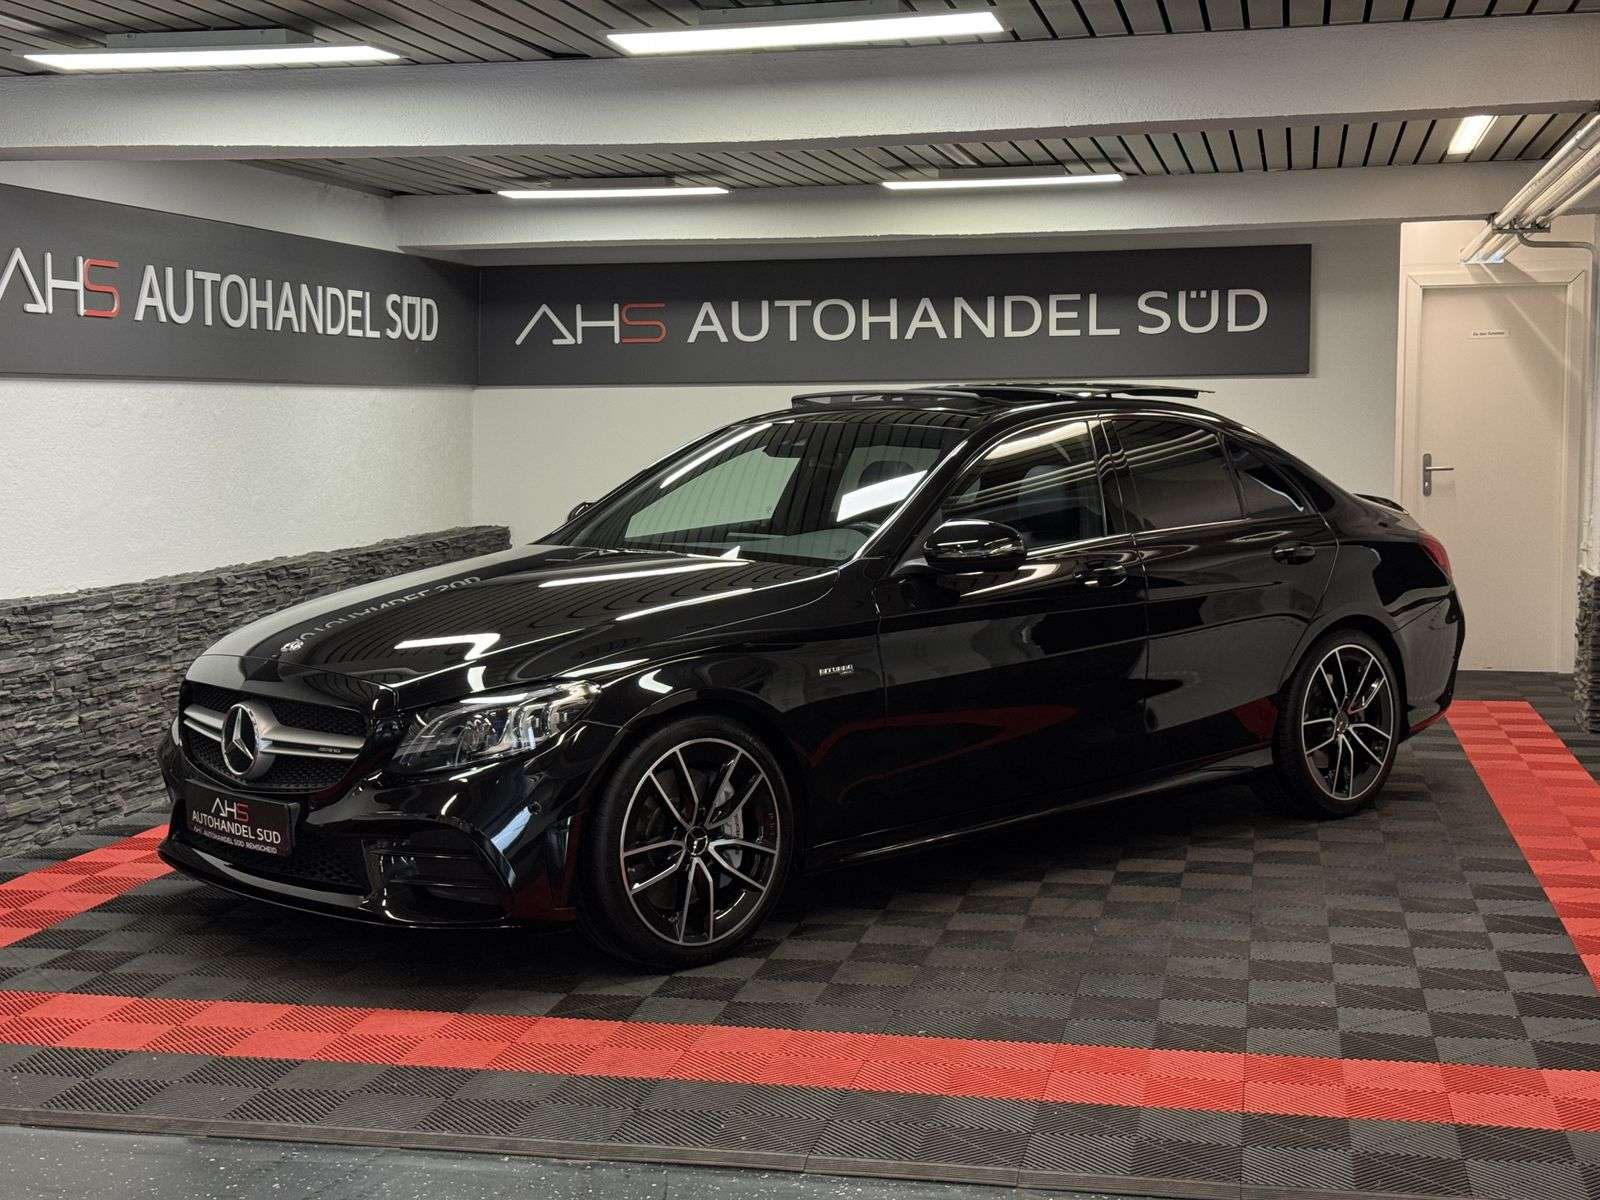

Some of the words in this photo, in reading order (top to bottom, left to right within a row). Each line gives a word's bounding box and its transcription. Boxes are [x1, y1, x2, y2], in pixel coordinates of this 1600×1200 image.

[0, 247, 121, 318] AHS
[134, 264, 381, 340] AUTOHANDEL
[386, 293, 438, 341] SÜD
[515, 302, 668, 346] AHS
[687, 292, 1121, 344] AUTOHANDEL
[1136, 287, 1269, 335] SÜD
[192, 810, 255, 839] AUTOHANDEL
[256, 827, 282, 845] SÜD
[211, 797, 249, 822] AHS
